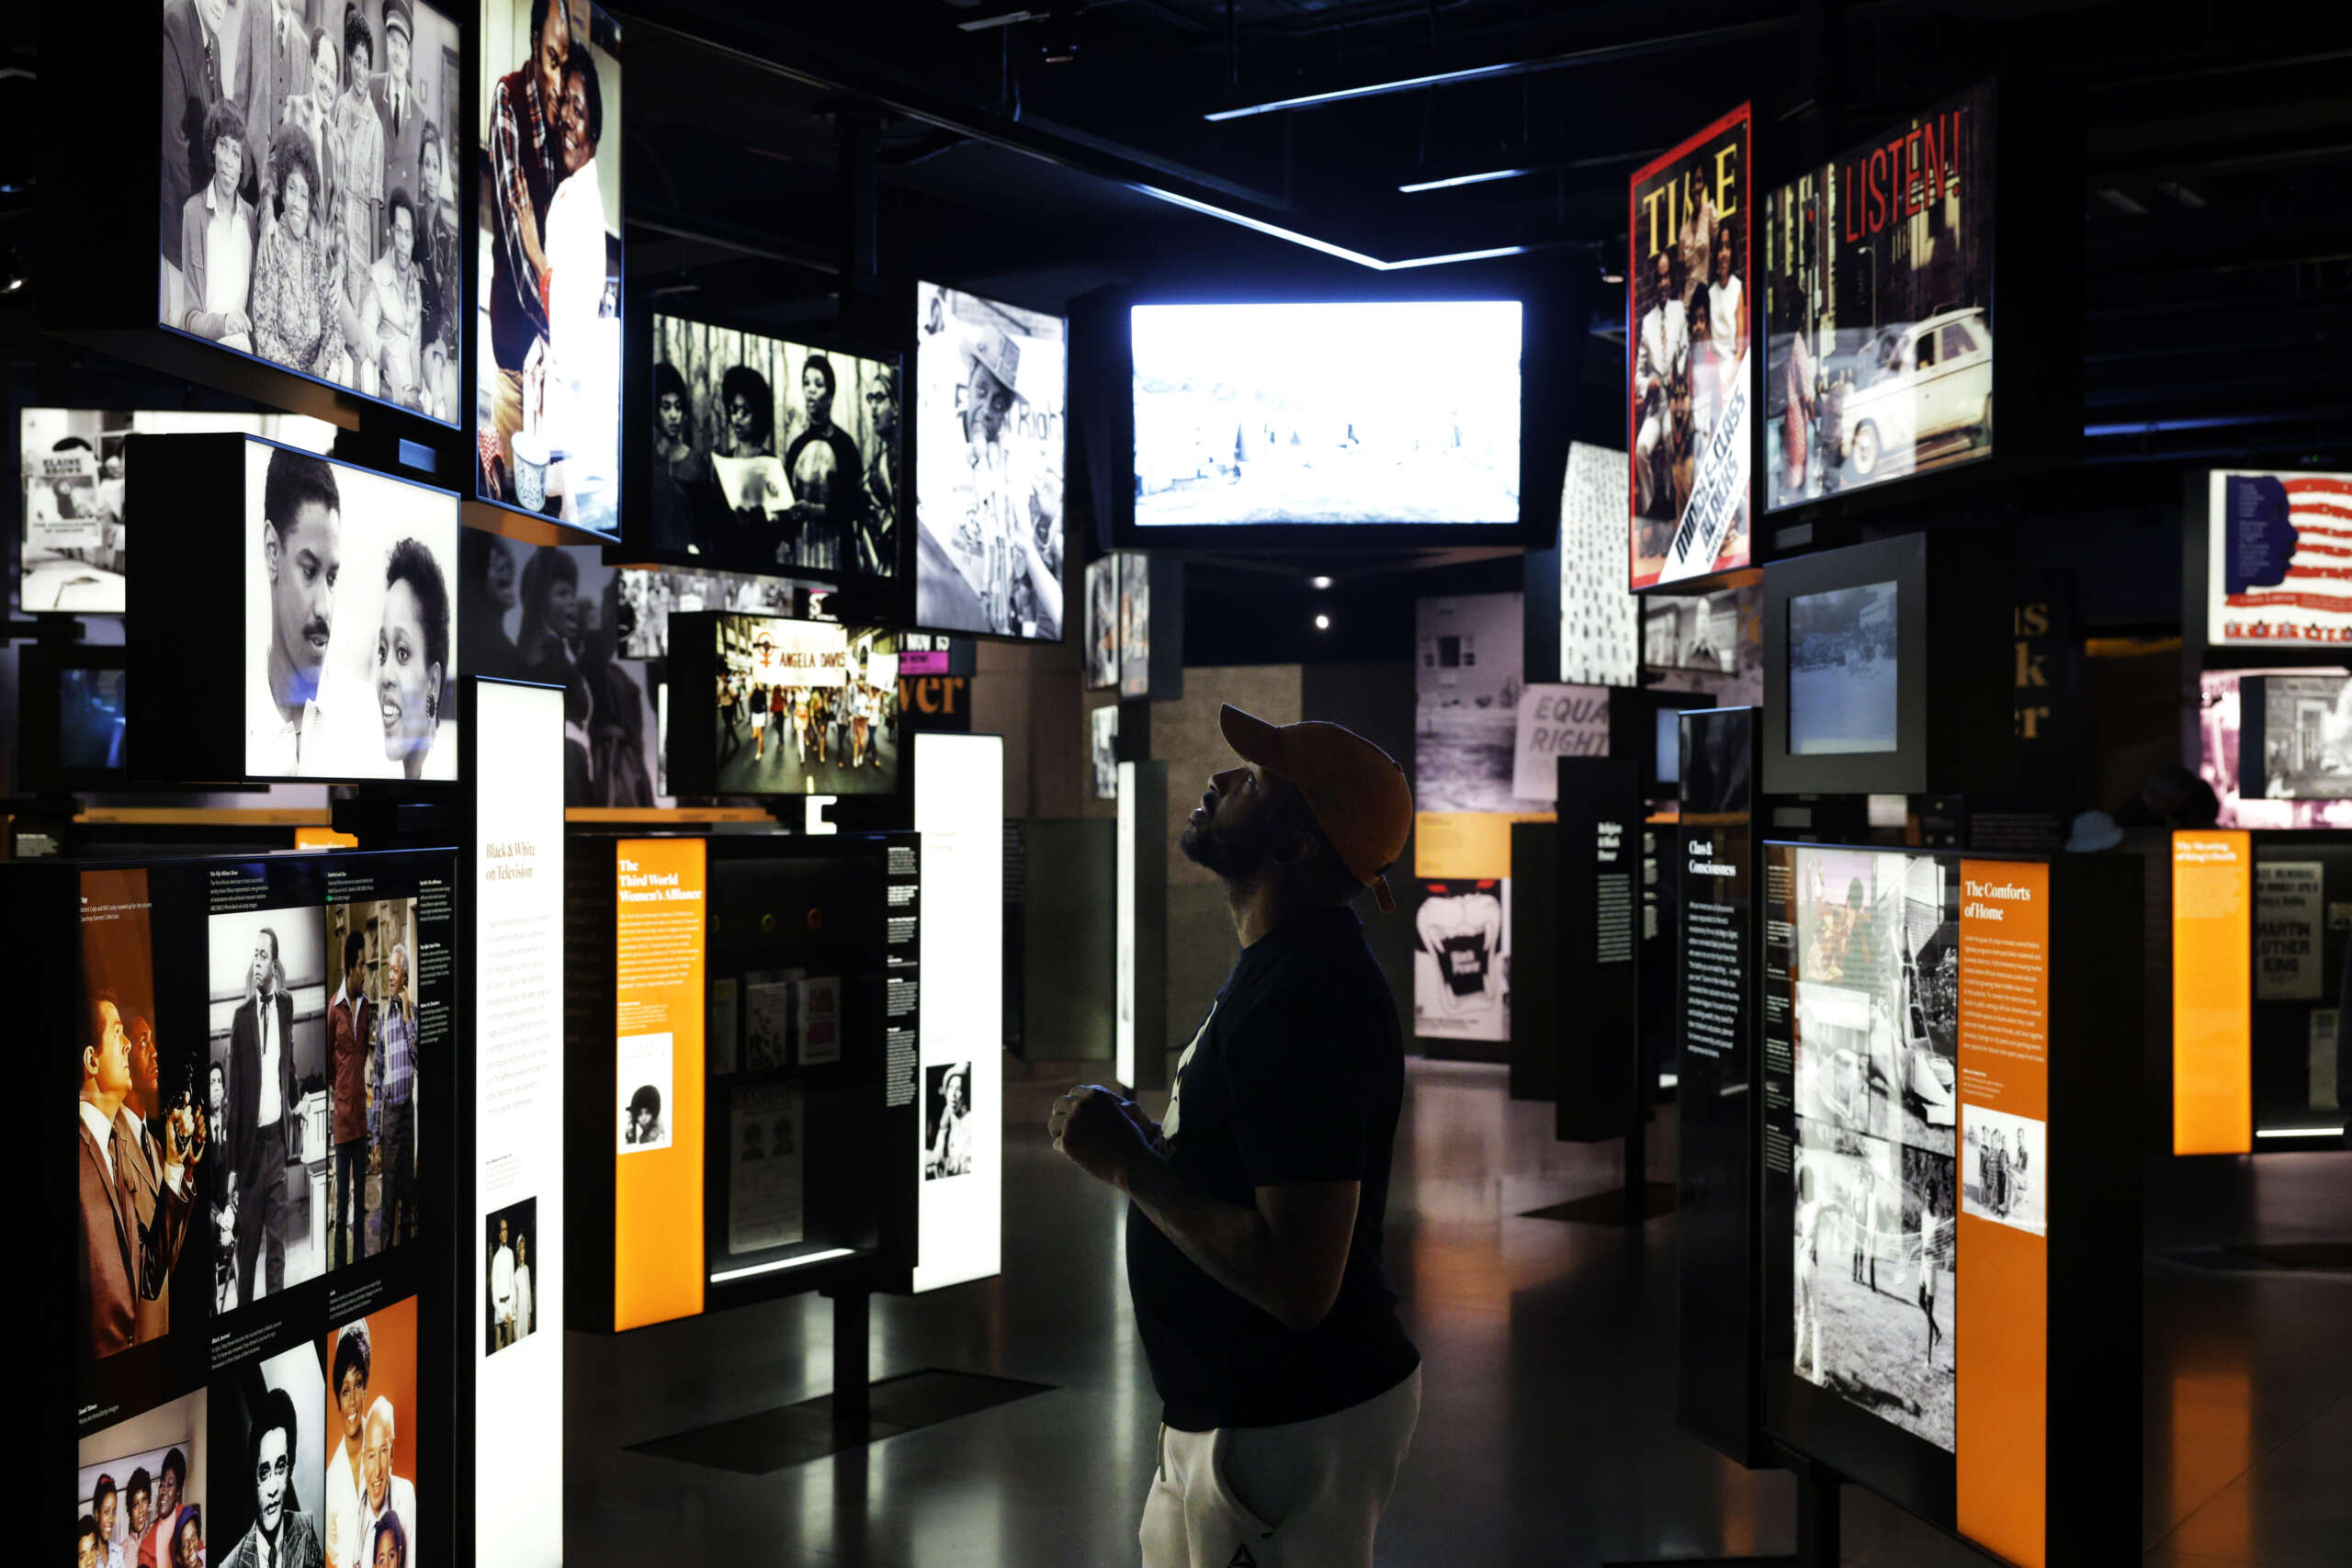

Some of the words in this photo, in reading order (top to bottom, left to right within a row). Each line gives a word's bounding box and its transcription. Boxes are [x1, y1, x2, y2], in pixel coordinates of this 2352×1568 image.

[1846, 111, 1960, 243] LISTEN!
[1700, 449, 1739, 549] BLACKS
[779, 652, 816, 669] ANGELA
[820, 651, 845, 668] DAVIS
[486, 842, 507, 858] Black
[514, 841, 537, 856] White
[485, 870, 496, 881] on
[497, 863, 534, 880] Television
[619, 860, 639, 872] The
[1689, 859, 1736, 876] Consciousness
[618, 875, 648, 887] Third
[649, 874, 679, 886] World
[618, 889, 663, 902] Women's
[665, 888, 702, 899] Alliance
[1964, 881, 1983, 897] The
[1984, 882, 2031, 901] Comforts
[1964, 902, 1974, 918] of
[1975, 904, 2004, 920] Home
